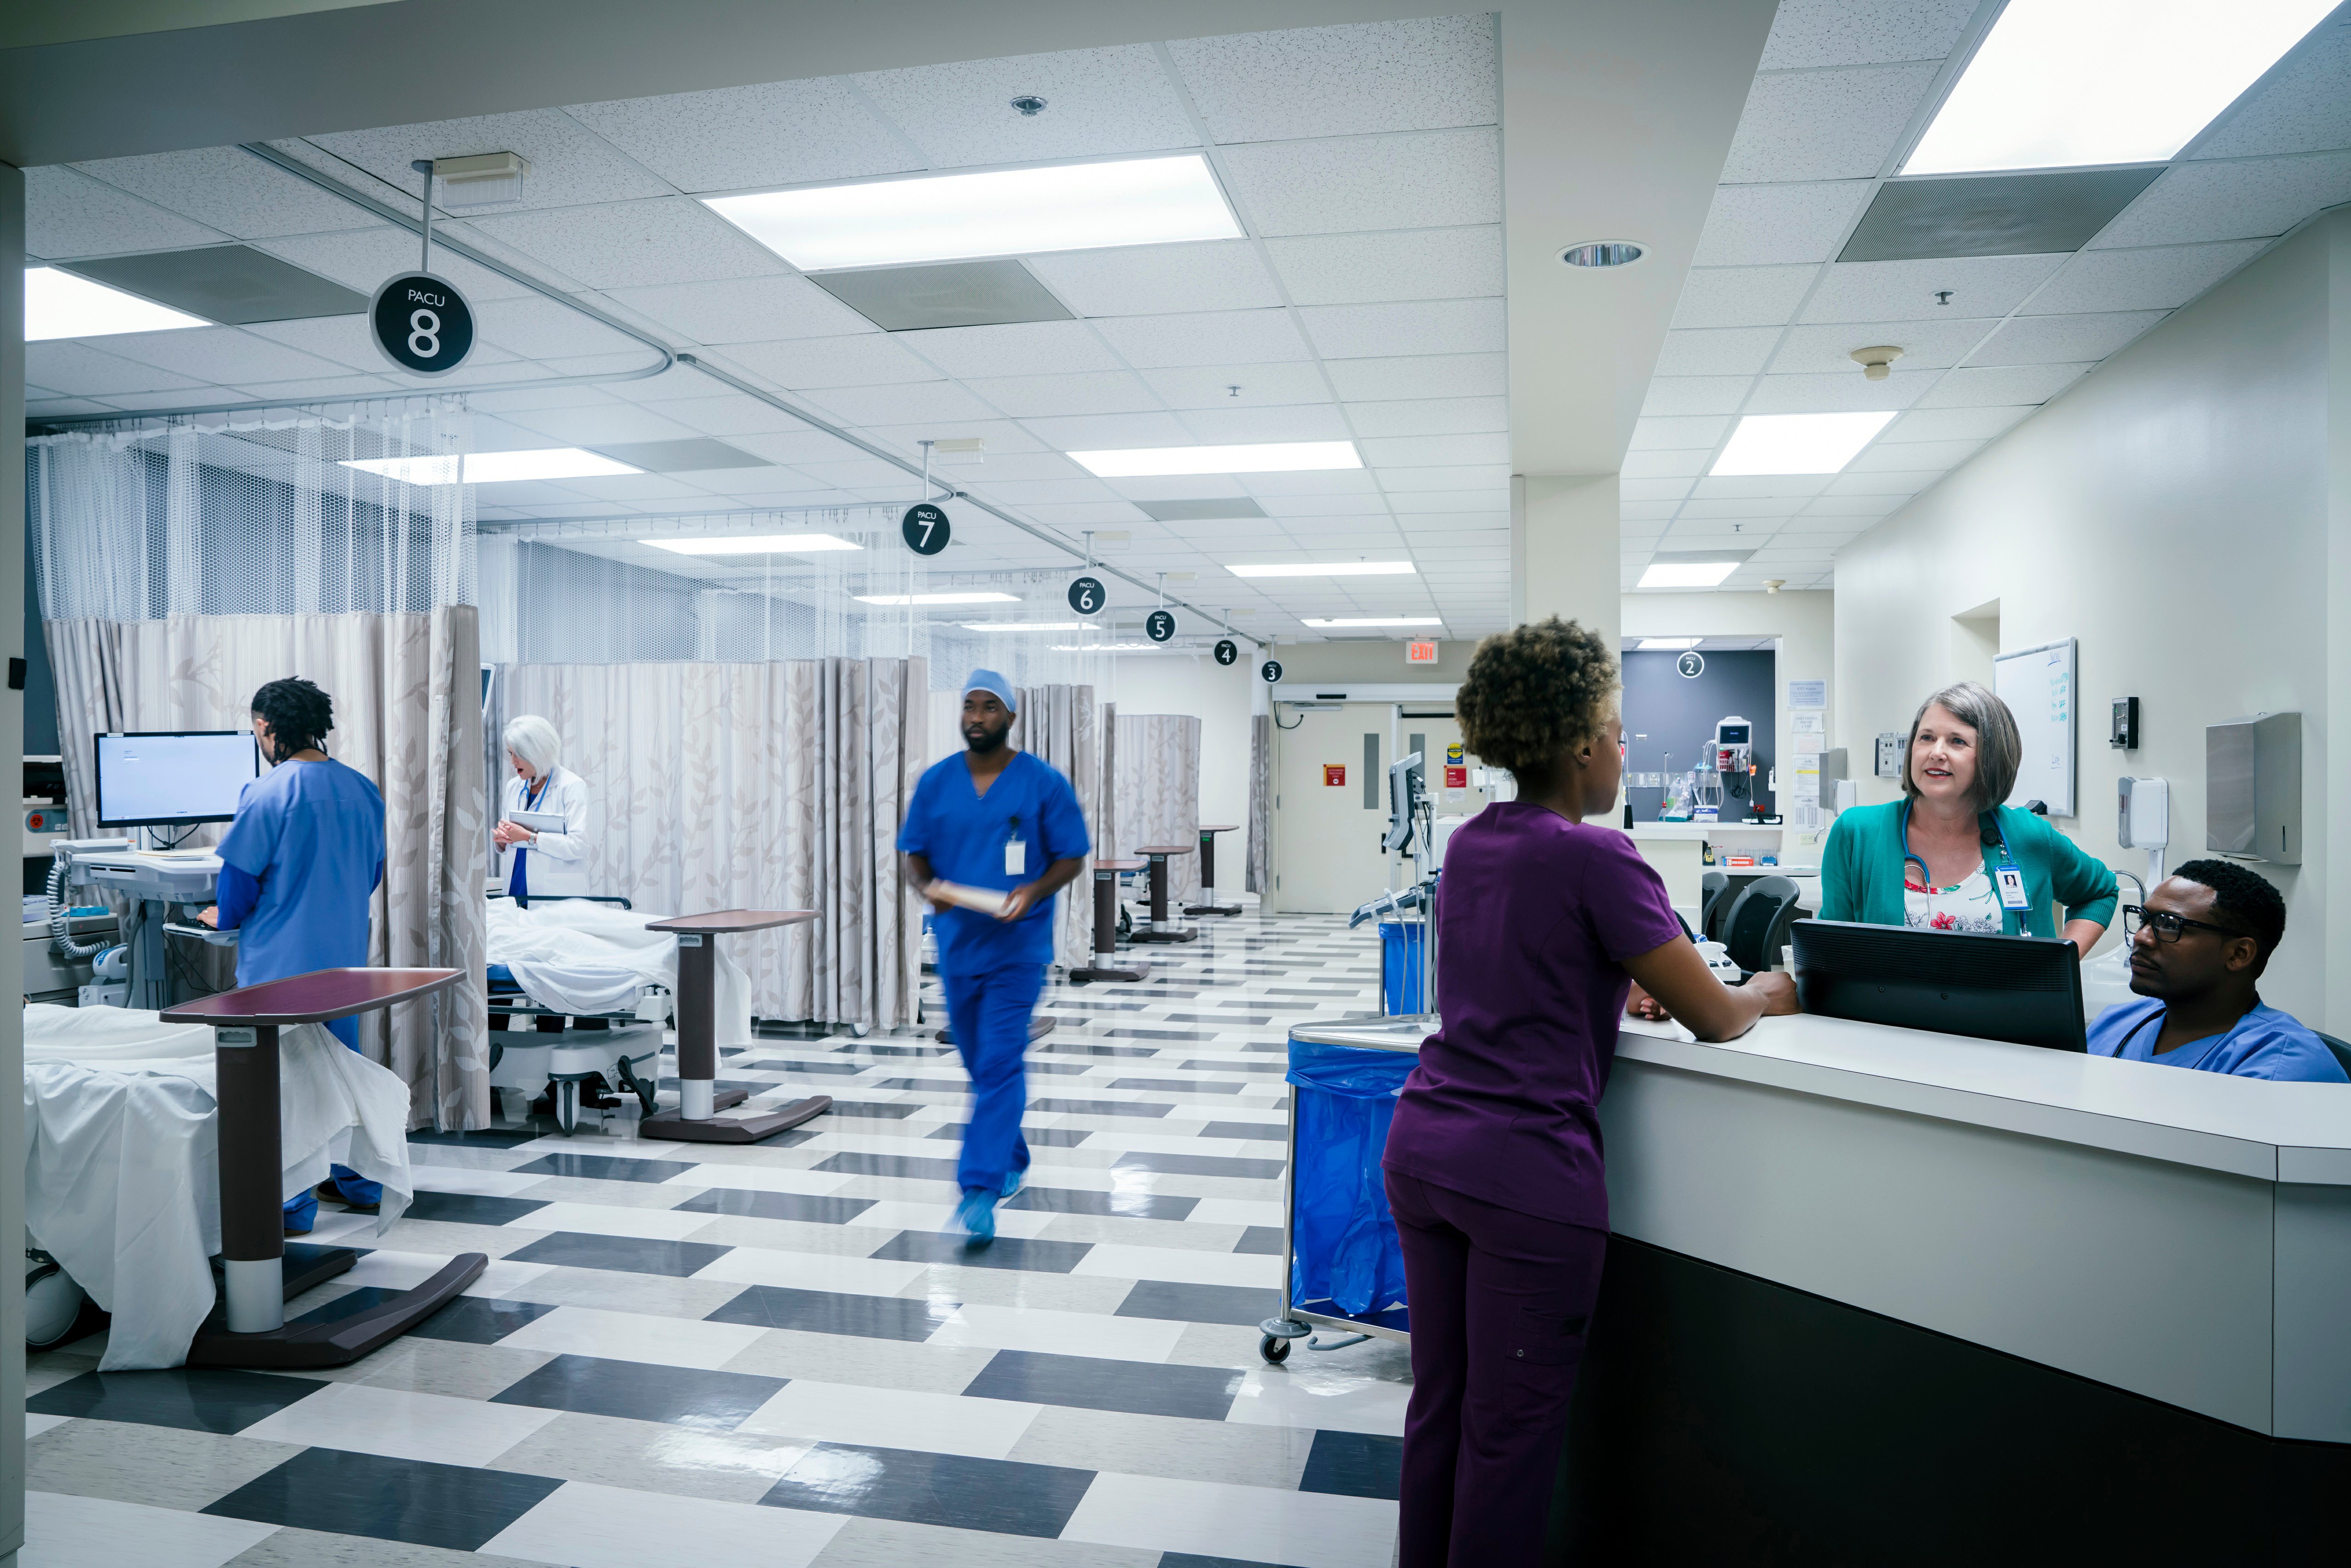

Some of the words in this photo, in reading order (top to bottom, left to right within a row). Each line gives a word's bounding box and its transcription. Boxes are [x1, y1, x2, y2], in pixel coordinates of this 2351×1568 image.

[408, 289, 445, 307] PACU
[408, 309, 440, 358] 8
[919, 521, 935, 548] 7
[1080, 589, 1093, 610] 6
[1156, 621, 1165, 638] 5
[1222, 648, 1231, 662] 4
[1411, 643, 1435, 660] EXIT
[1268, 668, 1276, 680] 3
[1686, 661, 1695, 674] 2
